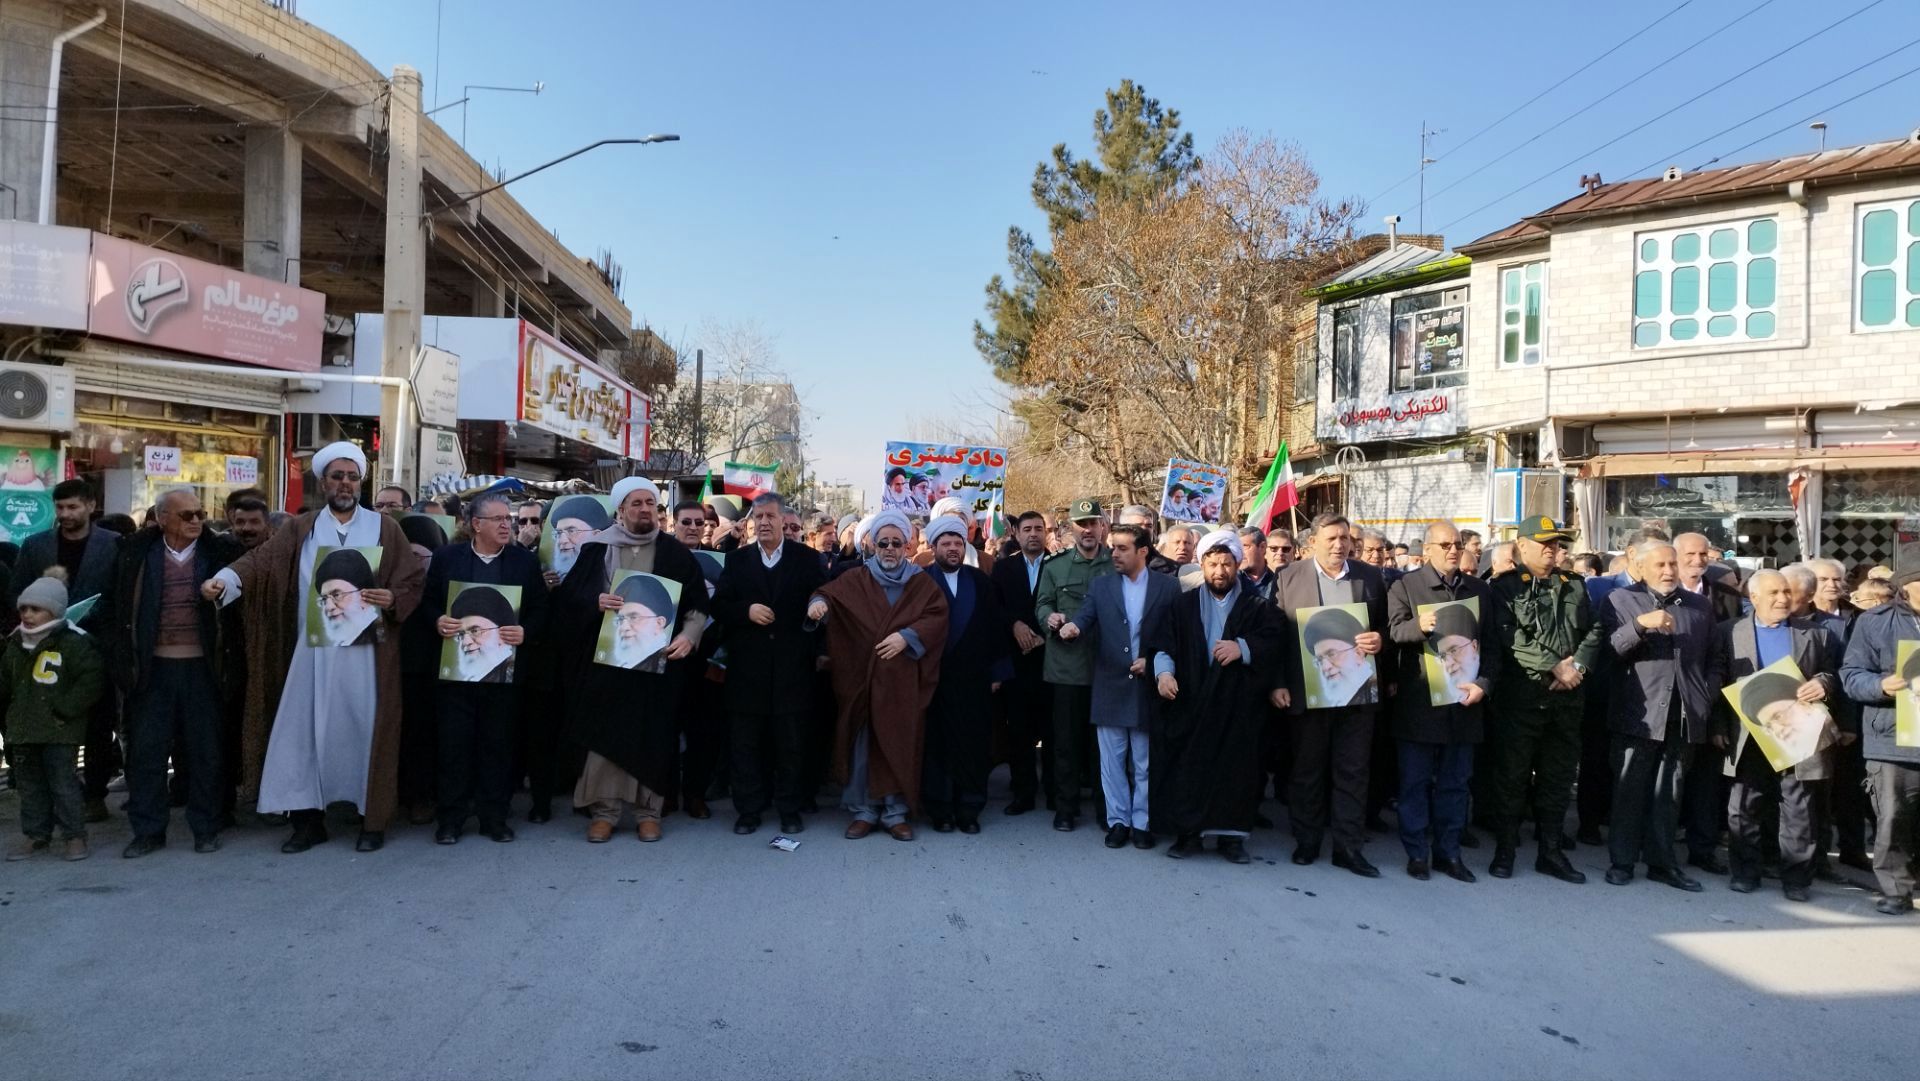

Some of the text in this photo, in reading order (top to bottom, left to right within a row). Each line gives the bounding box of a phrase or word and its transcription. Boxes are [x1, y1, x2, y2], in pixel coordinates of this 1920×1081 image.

[203, 279, 267, 314] سالم
[262, 292, 298, 326] مرغ
[1425, 332, 1457, 348] وحدت
[1394, 396, 1448, 421] الکتریکی
[151, 449, 174, 461] توزیع
[888, 447, 1004, 467] دادگستری
[951, 474, 1003, 492] شهرستان
[6, 505, 38, 513] Grade
[12, 512, 32, 526] A
[32, 650, 62, 685] C
